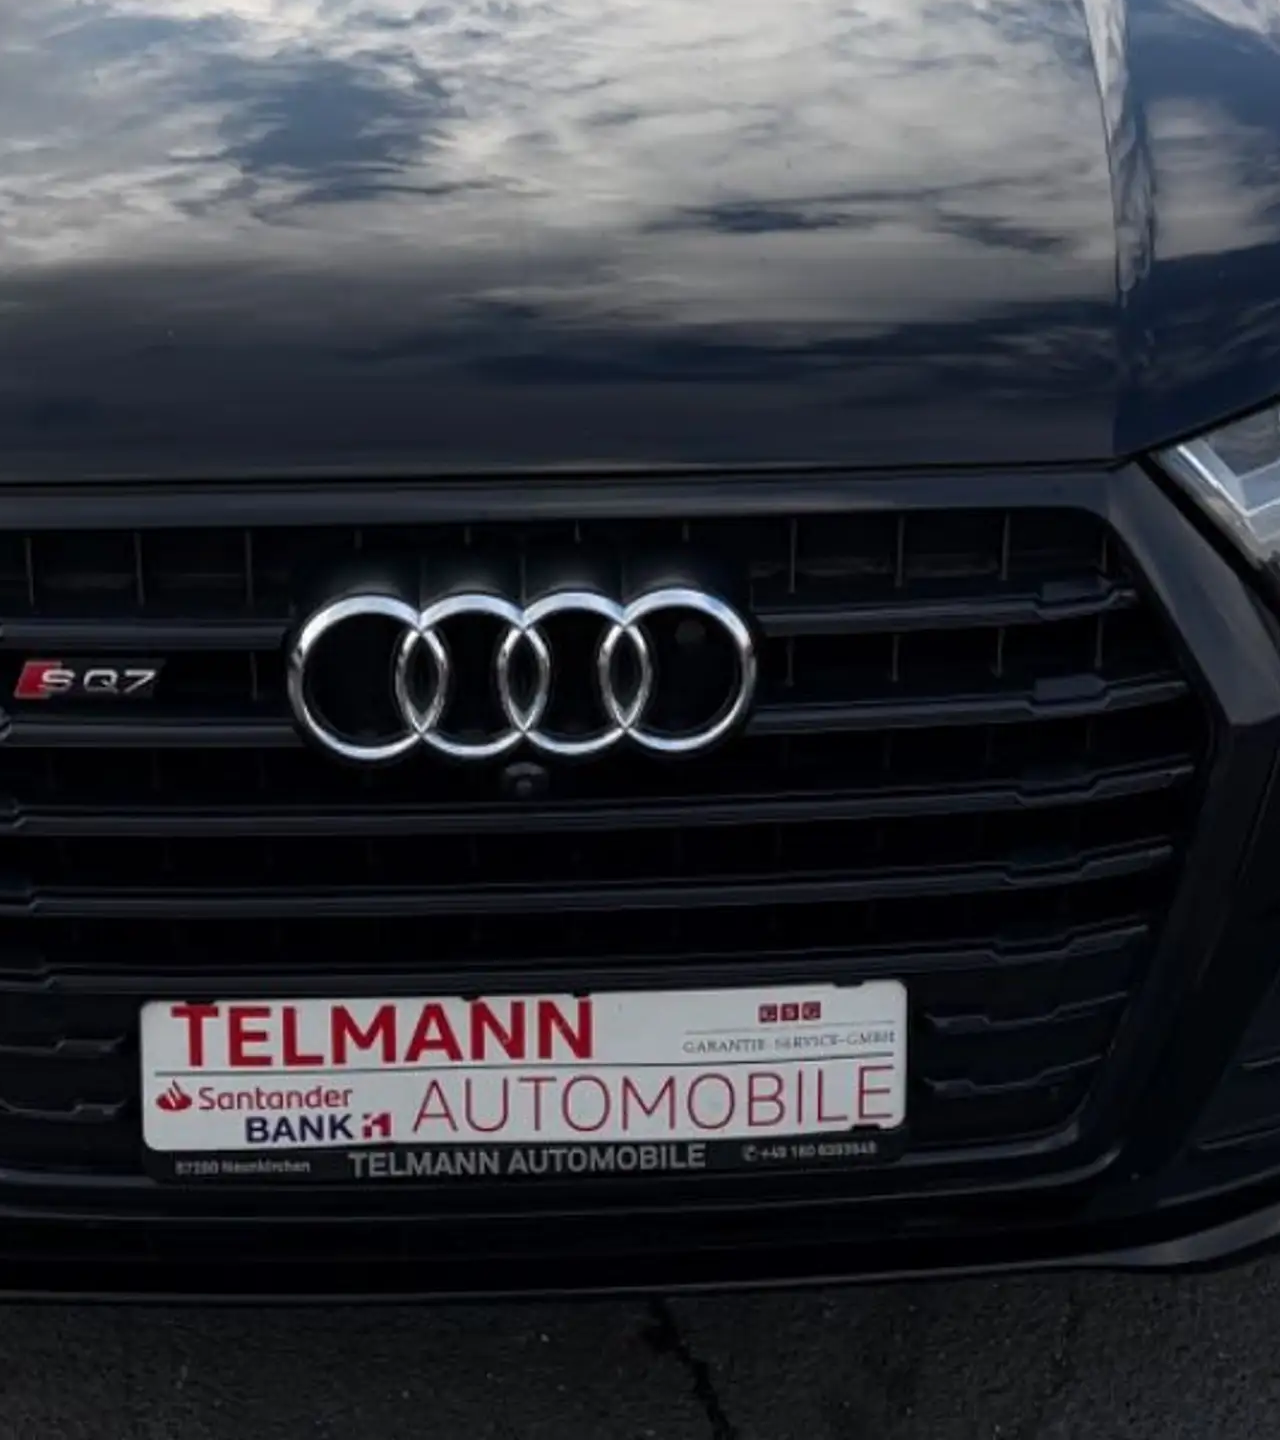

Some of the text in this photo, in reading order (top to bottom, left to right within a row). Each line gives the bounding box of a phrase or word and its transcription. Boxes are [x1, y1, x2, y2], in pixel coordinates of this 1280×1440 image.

[39, 669, 156, 694] SQ7
[171, 1000, 593, 1067] TELMANN
[682, 1038, 766, 1054] GARANTIE
[198, 1085, 354, 1111] Santander
[412, 1063, 896, 1133] AUTOMOBILE
[348, 1143, 706, 1179] TELMANN AUTOMOBILE
